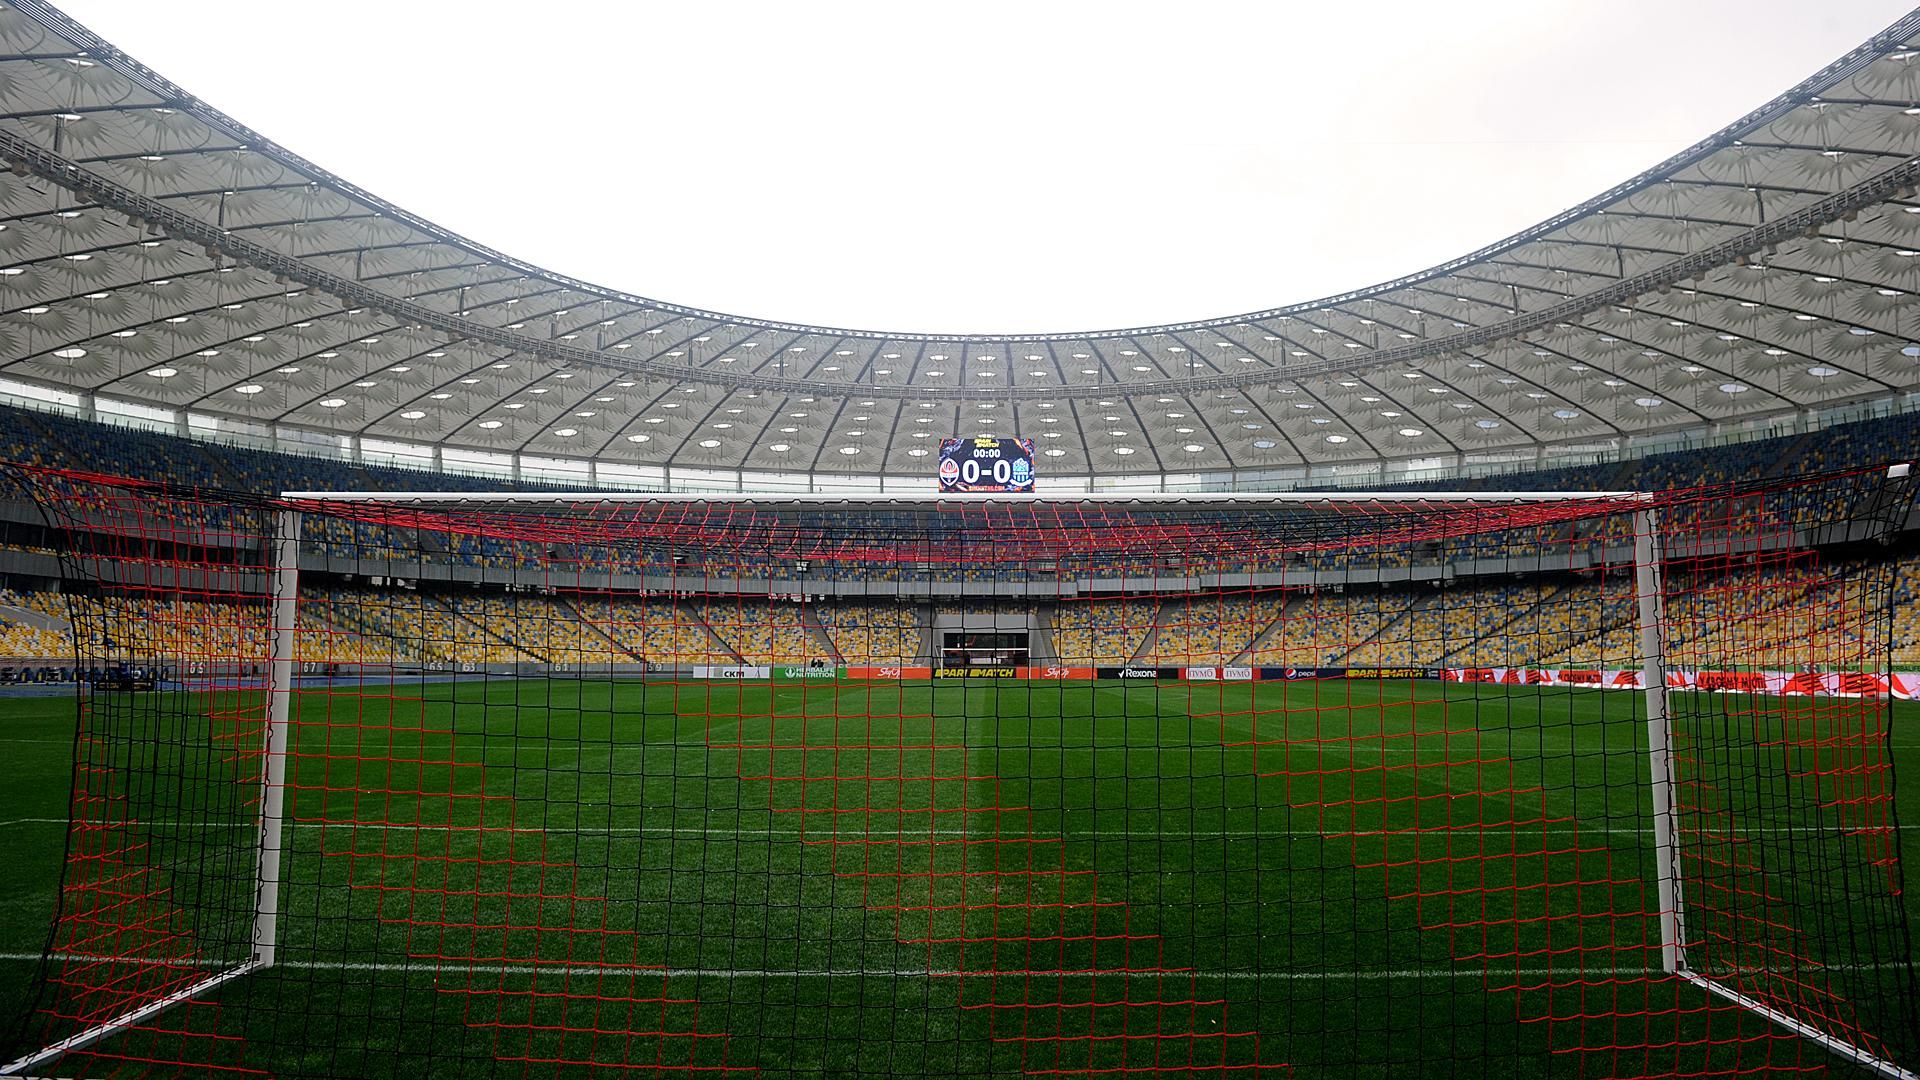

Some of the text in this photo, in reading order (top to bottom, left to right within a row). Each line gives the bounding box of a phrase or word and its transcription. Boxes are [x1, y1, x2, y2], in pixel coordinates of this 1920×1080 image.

[973, 449, 1000, 458] 00:00
[962, 460, 1010, 483] 0-0
[303, 662, 316, 672] 67
[429, 663, 443, 671] 65
[969, 669, 1014, 677] MATCH
[1125, 668, 1157, 678] Rexona
